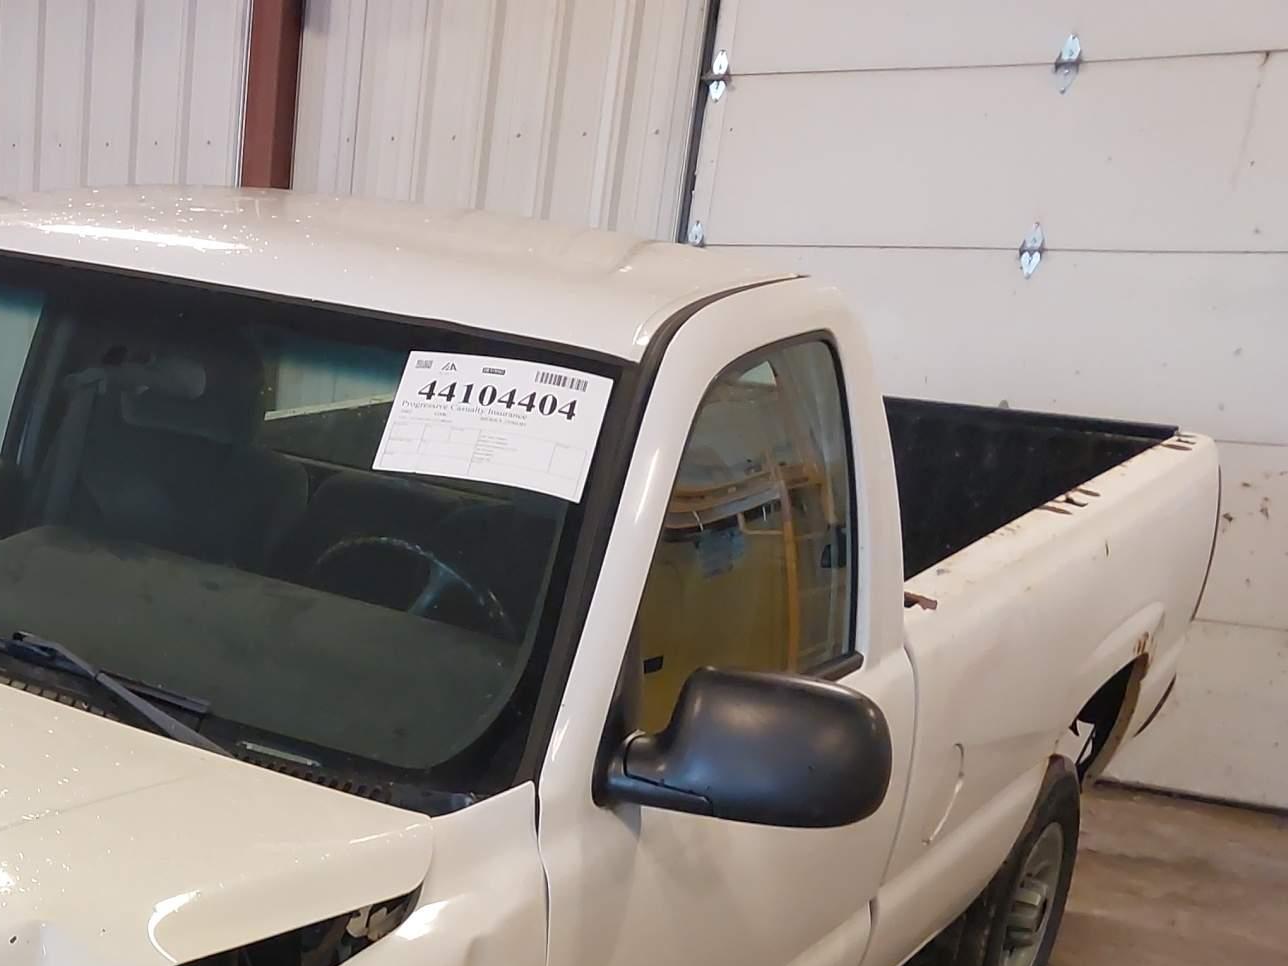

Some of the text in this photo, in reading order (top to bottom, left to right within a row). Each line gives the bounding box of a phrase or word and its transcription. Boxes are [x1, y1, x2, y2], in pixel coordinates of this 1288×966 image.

[402, 400, 449, 411] Progressive
[450, 402, 485, 416] Casualty
[488, 406, 528, 420] Insurance
[418, 380, 578, 420] 44104404
